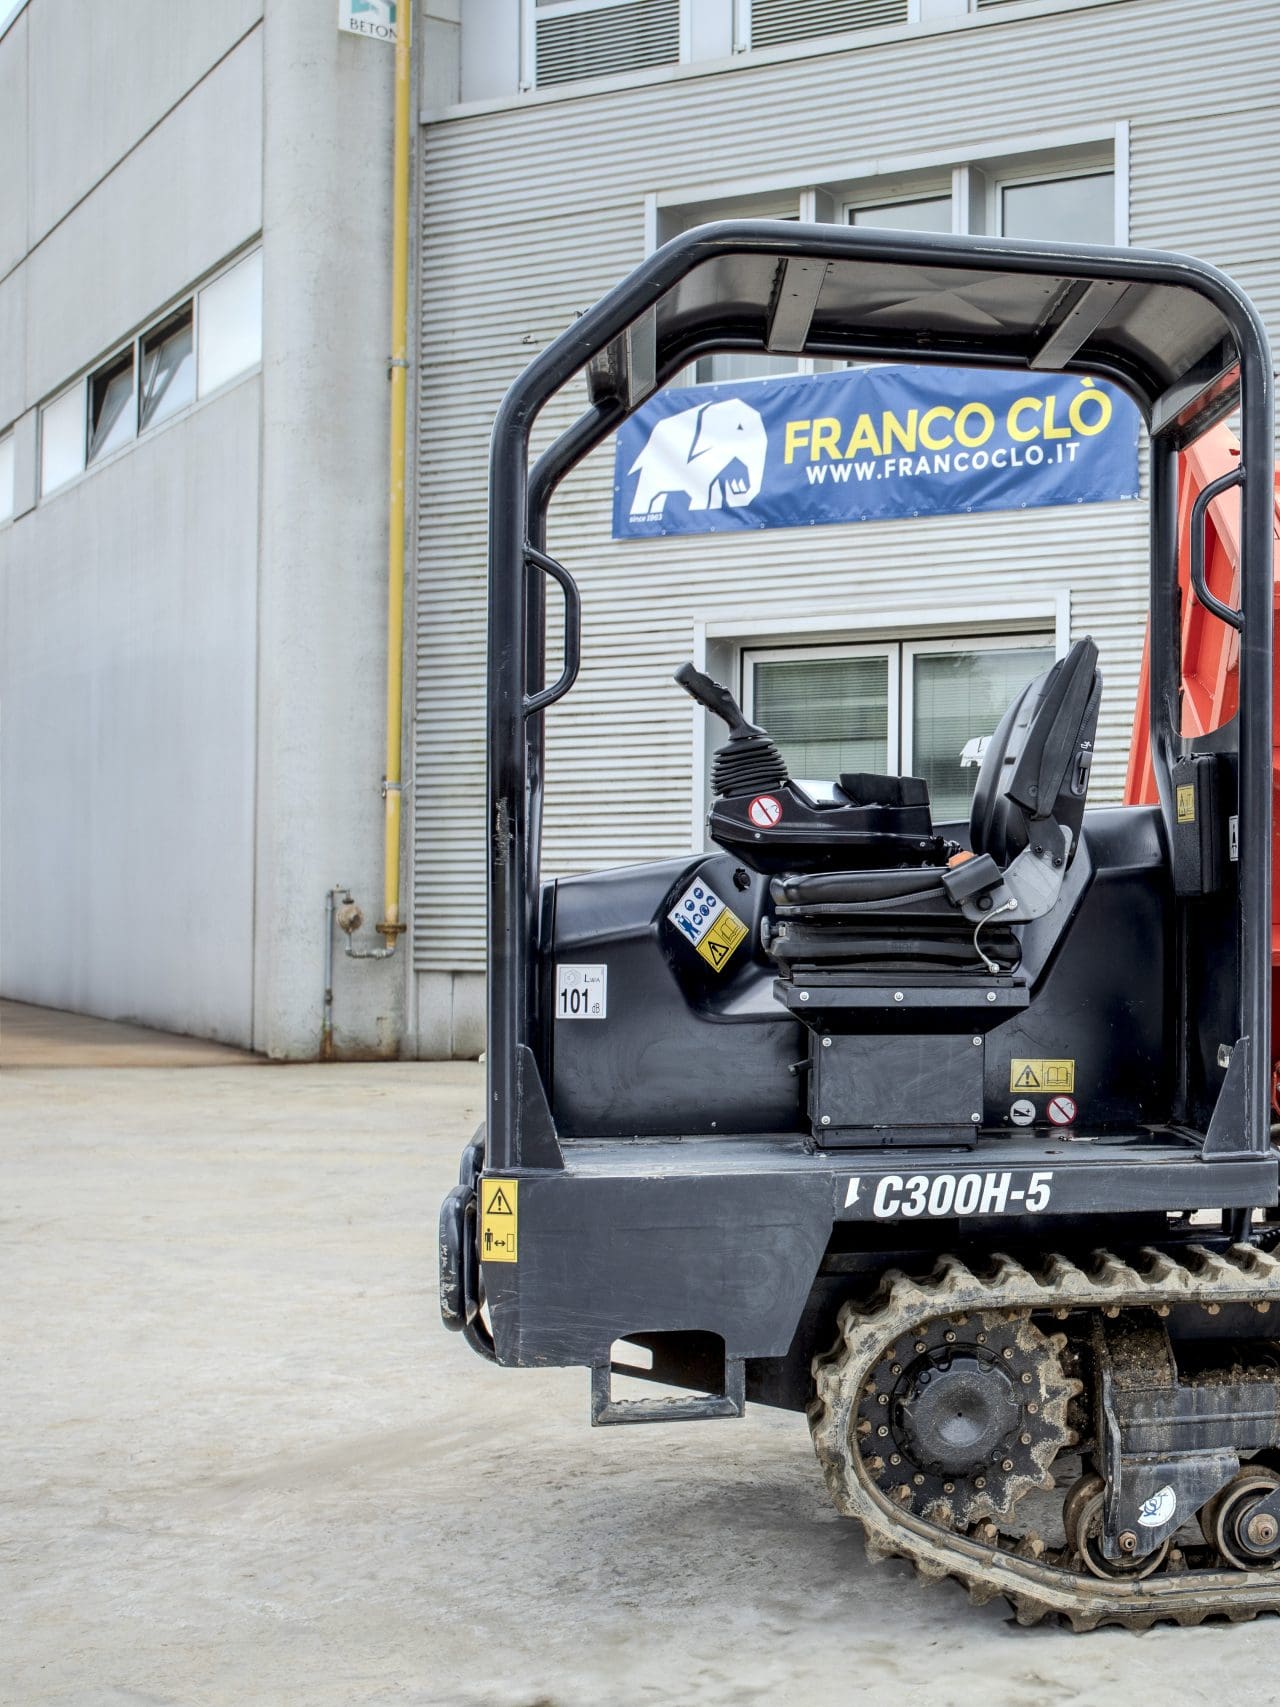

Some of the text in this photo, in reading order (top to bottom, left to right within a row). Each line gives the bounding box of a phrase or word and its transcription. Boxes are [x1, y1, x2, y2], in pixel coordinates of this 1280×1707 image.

[784, 376, 1112, 464] FRANCO CLÒ
[806, 442, 1080, 485] WWW.FRANCOCLO.IT
[561, 988, 588, 1013] 101
[873, 1171, 1054, 1218] C300H-5
